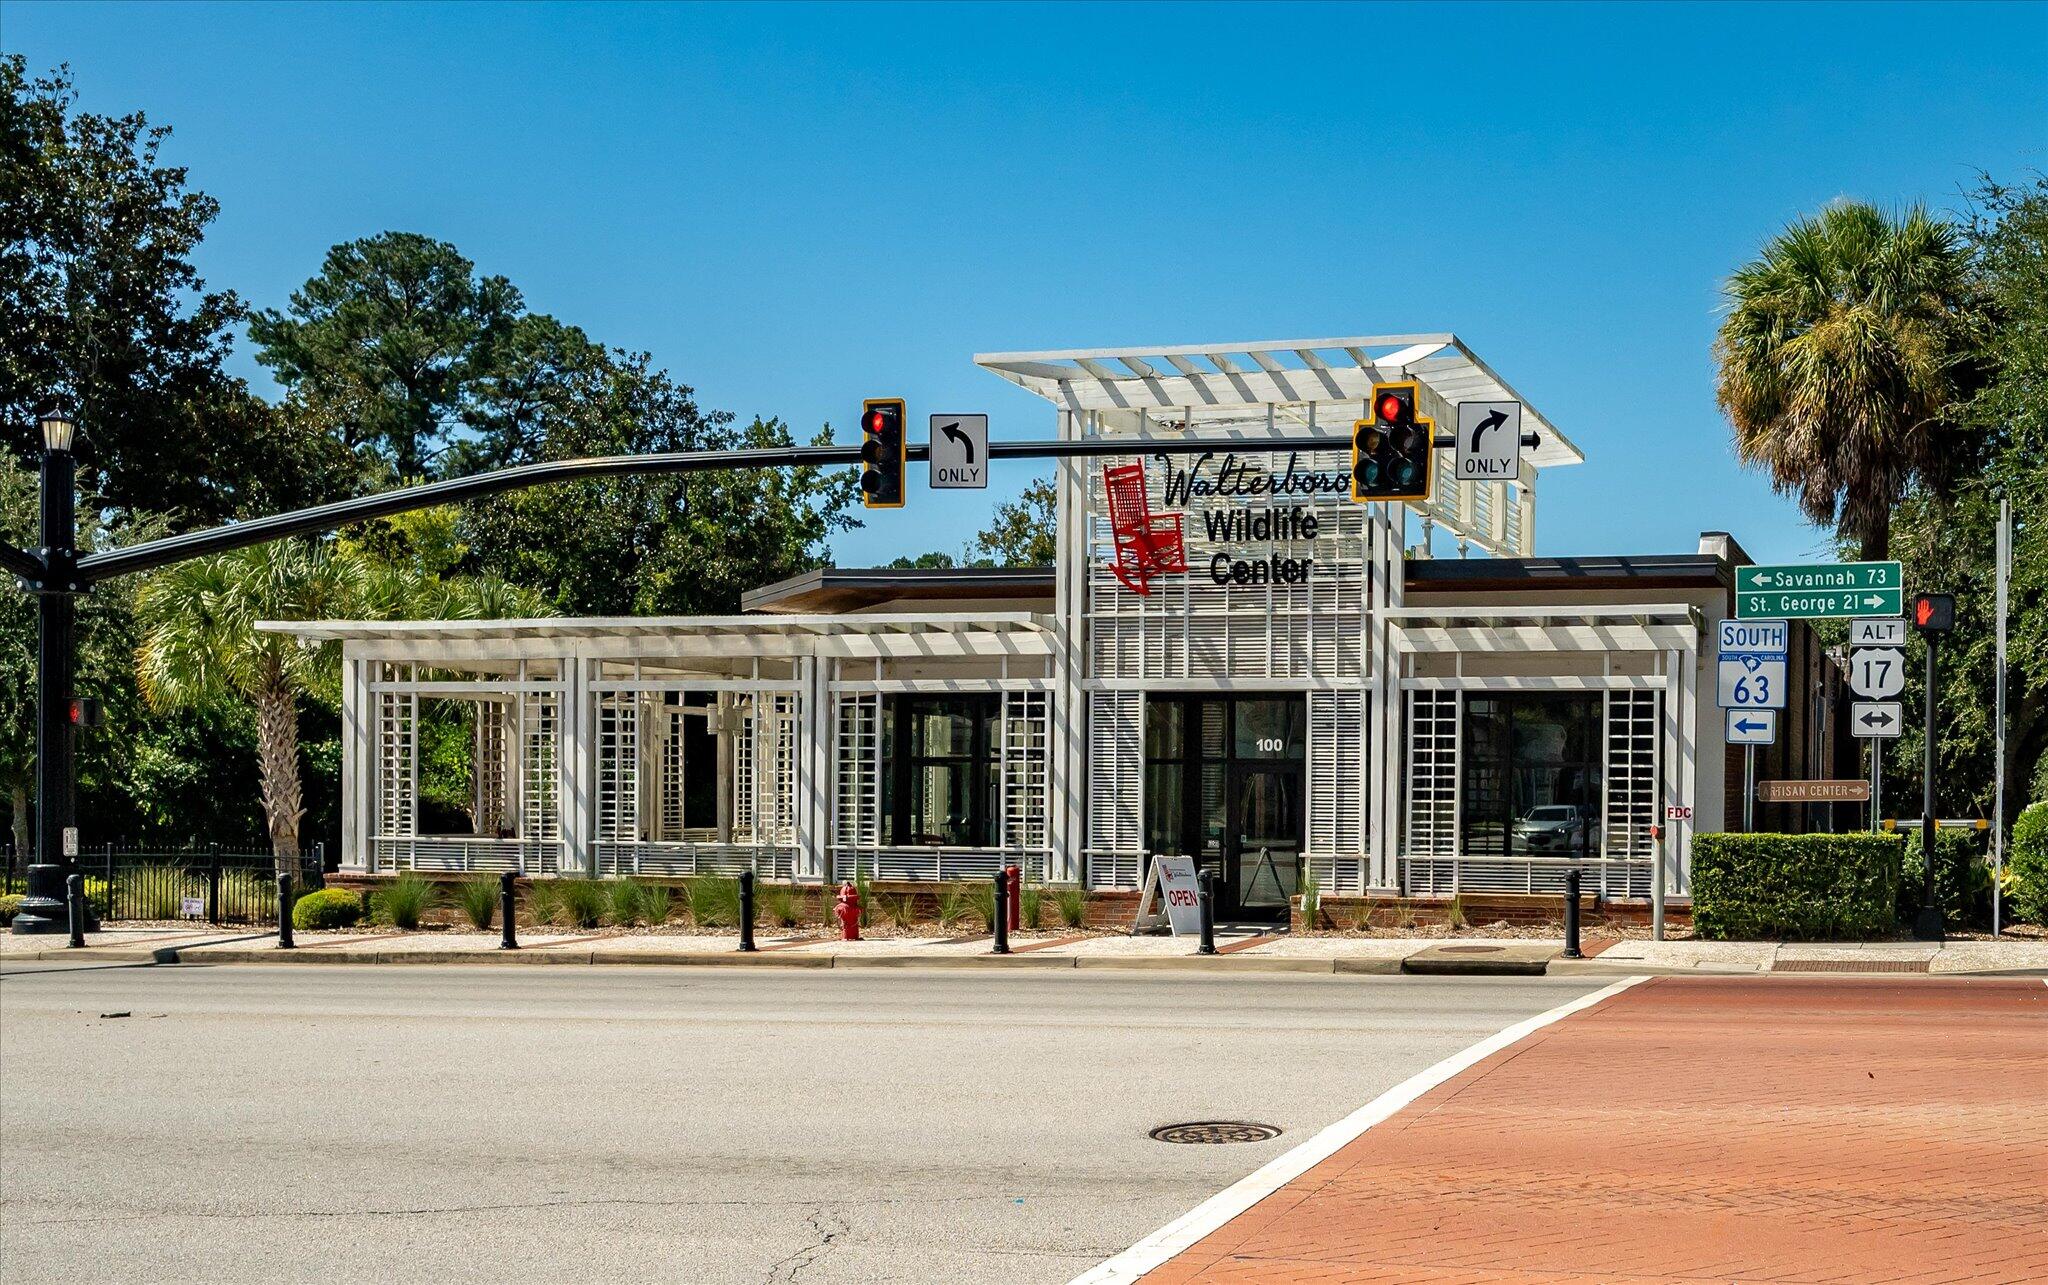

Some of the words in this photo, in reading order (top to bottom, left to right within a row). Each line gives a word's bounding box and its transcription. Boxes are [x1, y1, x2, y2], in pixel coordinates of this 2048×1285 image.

[938, 468, 980, 482] ONLY
[1465, 458, 1511, 474] ONLY
[1155, 452, 1352, 506] Walterboro
[1204, 507, 1318, 542] Wildlife
[1210, 552, 1313, 586] Center
[1775, 570, 1855, 587] Savannah
[1867, 569, 1887, 585] 73
[1750, 597, 1771, 612] St.
[1780, 595, 1836, 614] George
[1843, 594, 1858, 610] 21
[1723, 626, 1783, 647] SOUTH
[1862, 625, 1895, 640] ALT
[1863, 660, 1892, 689] 17
[1733, 675, 1770, 704] 63
[1256, 738, 1283, 752] 100
[1762, 786, 1806, 797] ARTISAN
[1810, 785, 1848, 796] CENTER
[1667, 807, 1692, 819] FDC
[1168, 890, 1199, 907] OPEN
